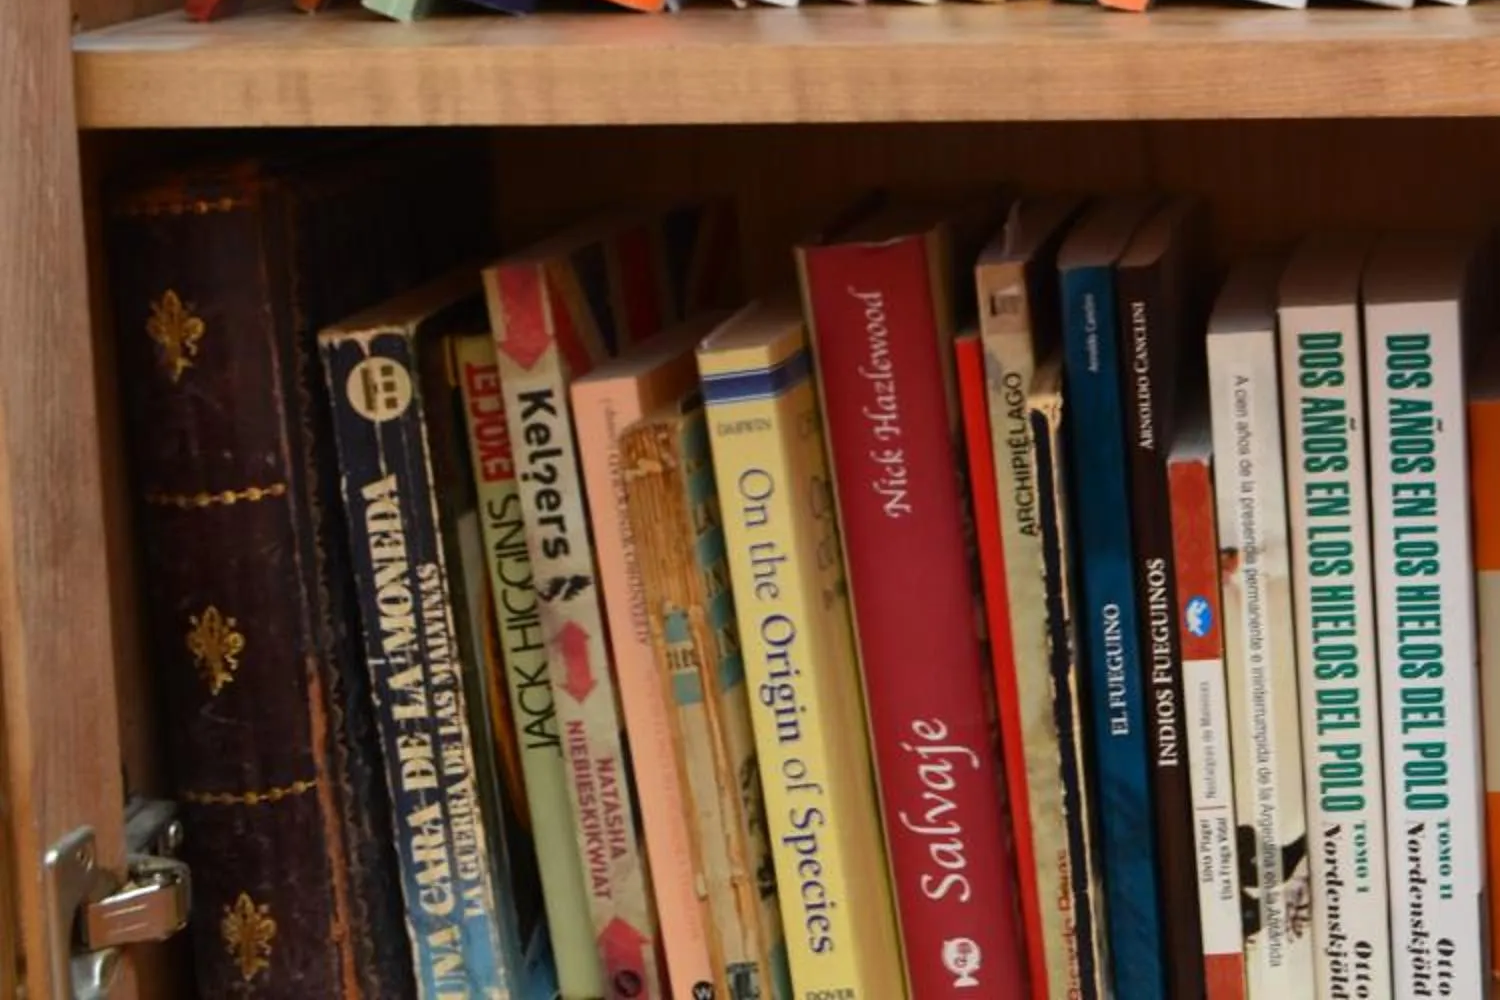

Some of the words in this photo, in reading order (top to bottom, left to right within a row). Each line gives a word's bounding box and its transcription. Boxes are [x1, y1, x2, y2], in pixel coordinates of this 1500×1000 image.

[848, 282, 900, 442] Hazlewood
[1130, 301, 1148, 373] CANCLINI
[1296, 330, 1343, 388] DOS
[1384, 333, 1432, 390] DOS
[465, 357, 516, 483] EXOCET
[1135, 376, 1154, 448] ARNOLDO
[1299, 395, 1356, 473] AÑOS
[1387, 396, 1443, 474] AÑOS
[869, 447, 912, 519] Nick
[1000, 371, 1037, 537] ARCHIPIÉLAGO
[735, 465, 778, 529] On
[1304, 480, 1349, 518] EN
[1391, 482, 1436, 518] EN
[360, 475, 417, 654] MONEDA
[485, 492, 544, 653] HIGGINS
[748, 539, 792, 600] the
[1306, 525, 1352, 578] LOS
[1392, 525, 1439, 578] LOS
[415, 561, 454, 684] MALVINAS
[1102, 603, 1126, 707] FUEGUINO
[1144, 557, 1173, 683] FUEGUINOS
[1309, 585, 1357, 681] HIELOS
[1394, 585, 1443, 680] HIELOS
[387, 661, 428, 721] LA
[432, 688, 460, 735] LAS
[512, 661, 560, 751] JACK
[746, 612, 813, 745] Origin
[1313, 688, 1360, 737] DEL
[1398, 687, 1445, 735] DEL
[439, 742, 465, 774] DE
[1110, 712, 1128, 735] EL
[1152, 689, 1178, 767] INDIOS
[398, 732, 437, 792] DE
[781, 755, 822, 799] of
[1316, 743, 1364, 814] POLO
[1401, 741, 1448, 812] POLO
[444, 777, 481, 880] GUERRA
[566, 720, 612, 901] NIEBIESKIKWIAT
[595, 757, 628, 859] NATASHA
[898, 717, 979, 904] Salvaje
[406, 795, 455, 918] CARA
[777, 804, 845, 955] Species
[460, 884, 485, 918] LA
[1315, 823, 1352, 1000] Nordenskjöld
[1397, 820, 1436, 999] Nordenskjöld
[1352, 939, 1375, 998] Otto
[1433, 936, 1459, 998] Otto
